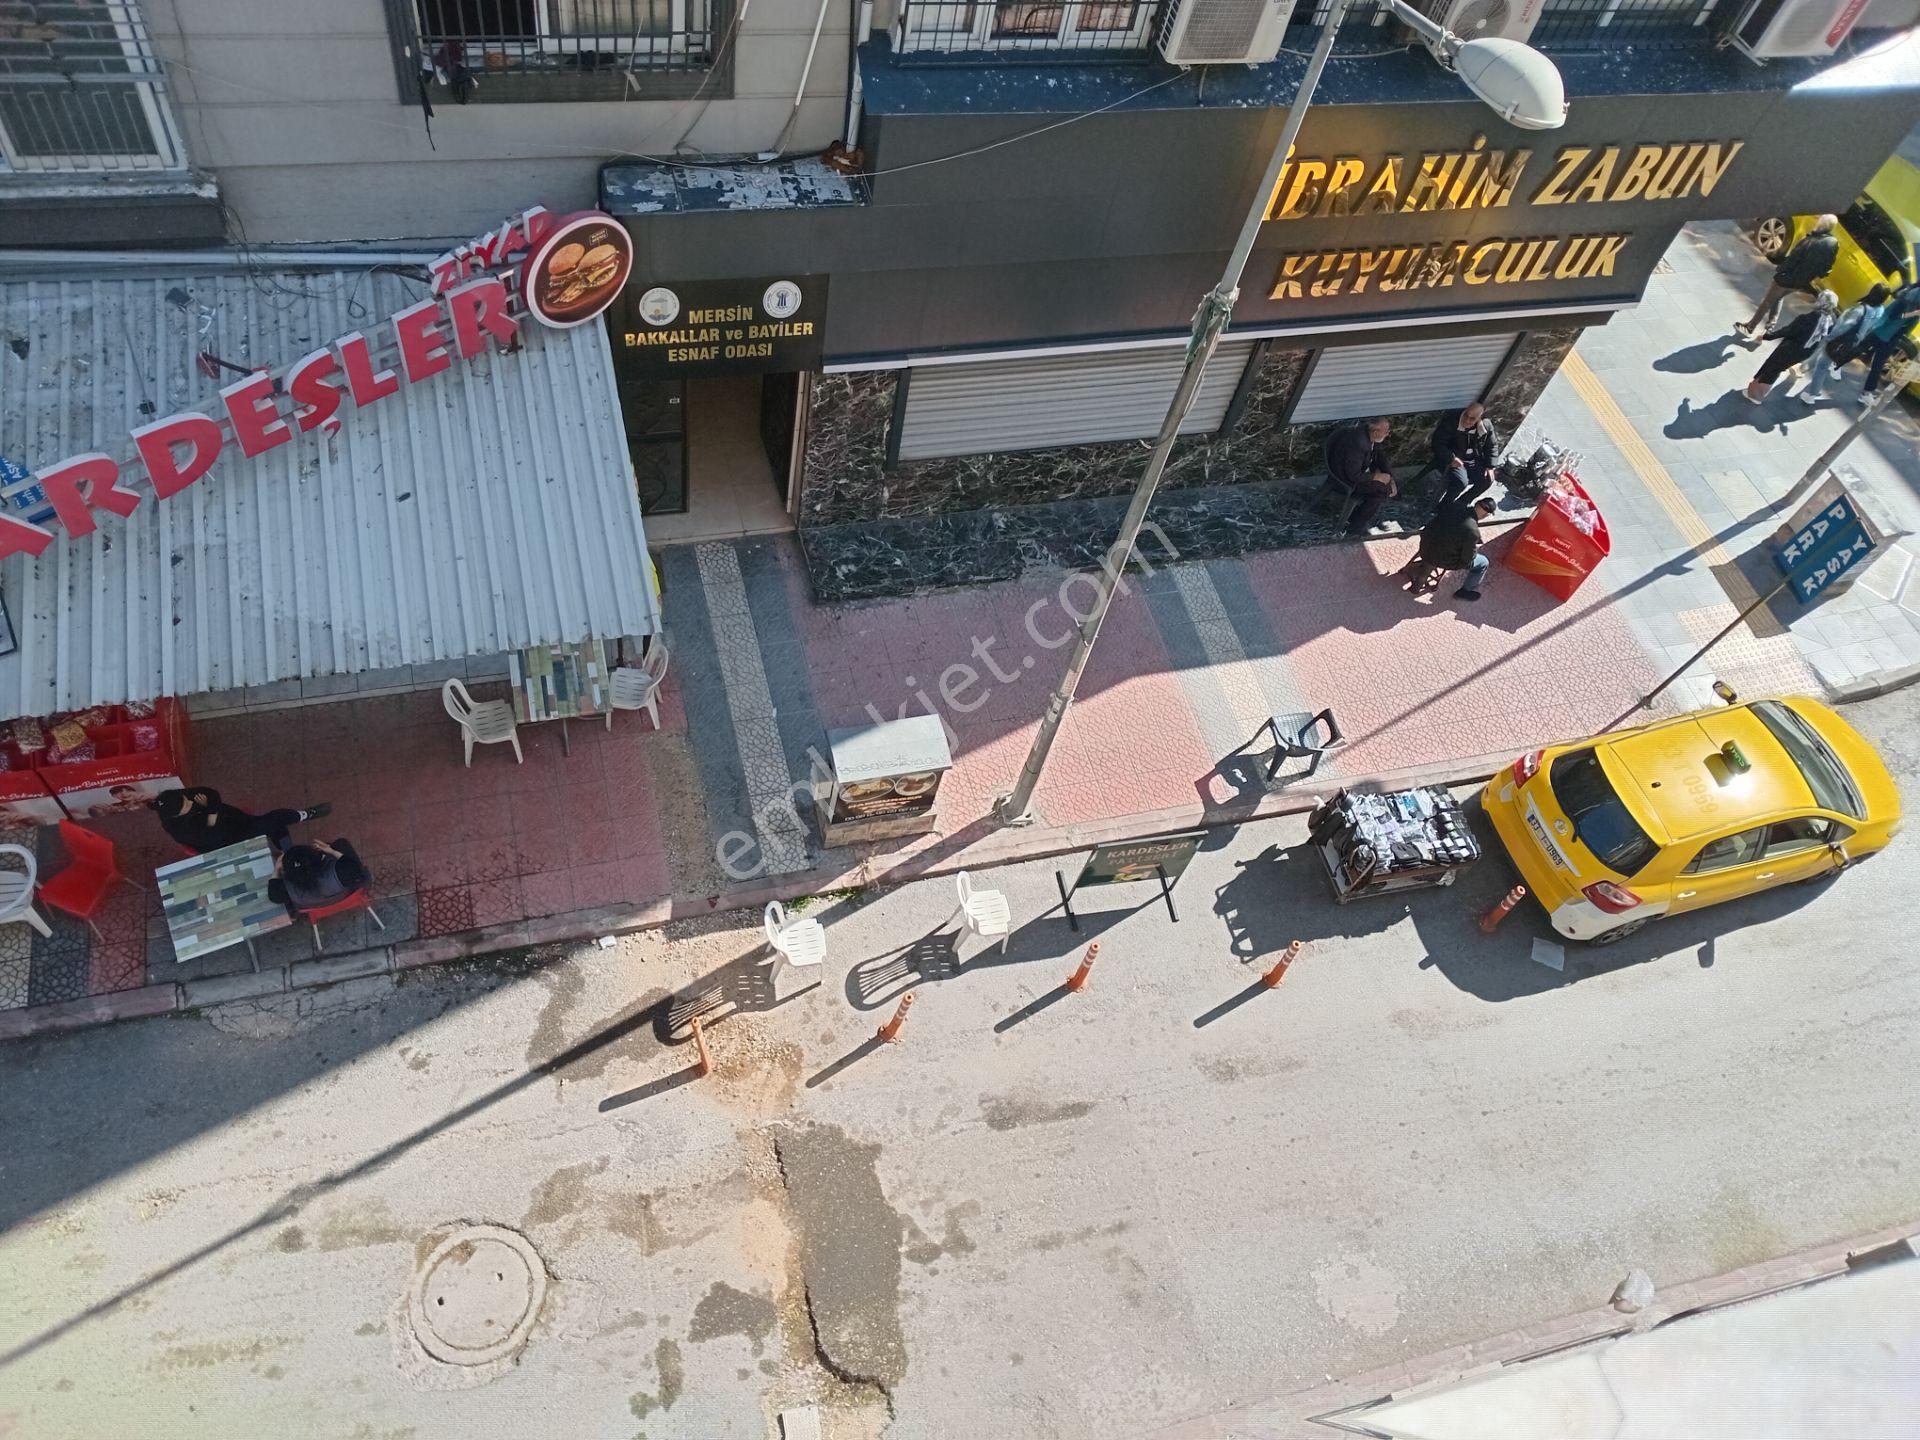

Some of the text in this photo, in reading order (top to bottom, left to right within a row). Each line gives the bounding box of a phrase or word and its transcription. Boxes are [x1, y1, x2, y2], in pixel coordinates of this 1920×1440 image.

[1532, 142, 1744, 206] ZABUN
[1269, 233, 1635, 300] KUYUMCULUK
[625, 322, 814, 347] BAKKALLAR ve BAYİLER
[689, 305, 753, 324] MERSİN
[668, 343, 773, 362] ESNAF ODASI
[1783, 503, 1847, 565] PARK
[1802, 534, 1868, 596] YASAK
